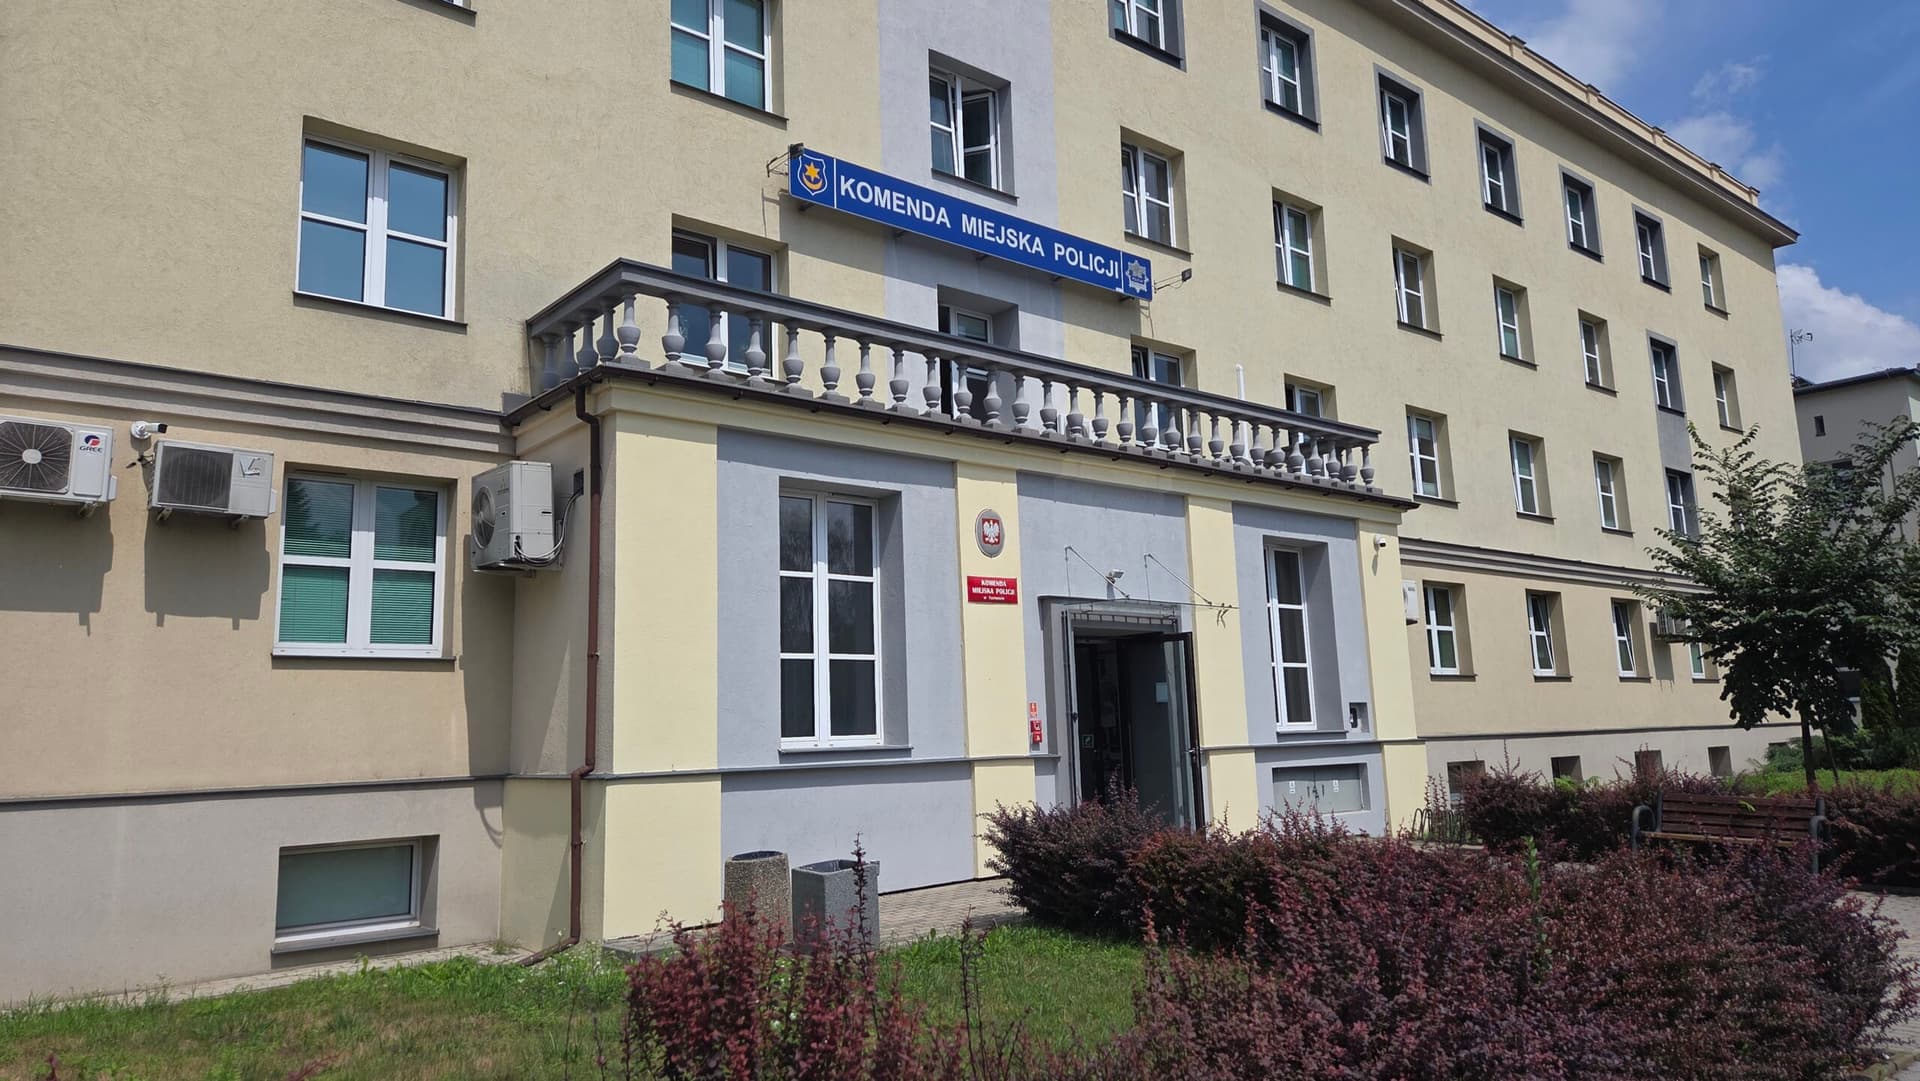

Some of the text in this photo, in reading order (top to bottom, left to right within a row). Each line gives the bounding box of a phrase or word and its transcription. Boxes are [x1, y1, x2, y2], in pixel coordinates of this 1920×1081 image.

[840, 175, 1119, 279] KOMENDA MIEJSKA POLICJI
